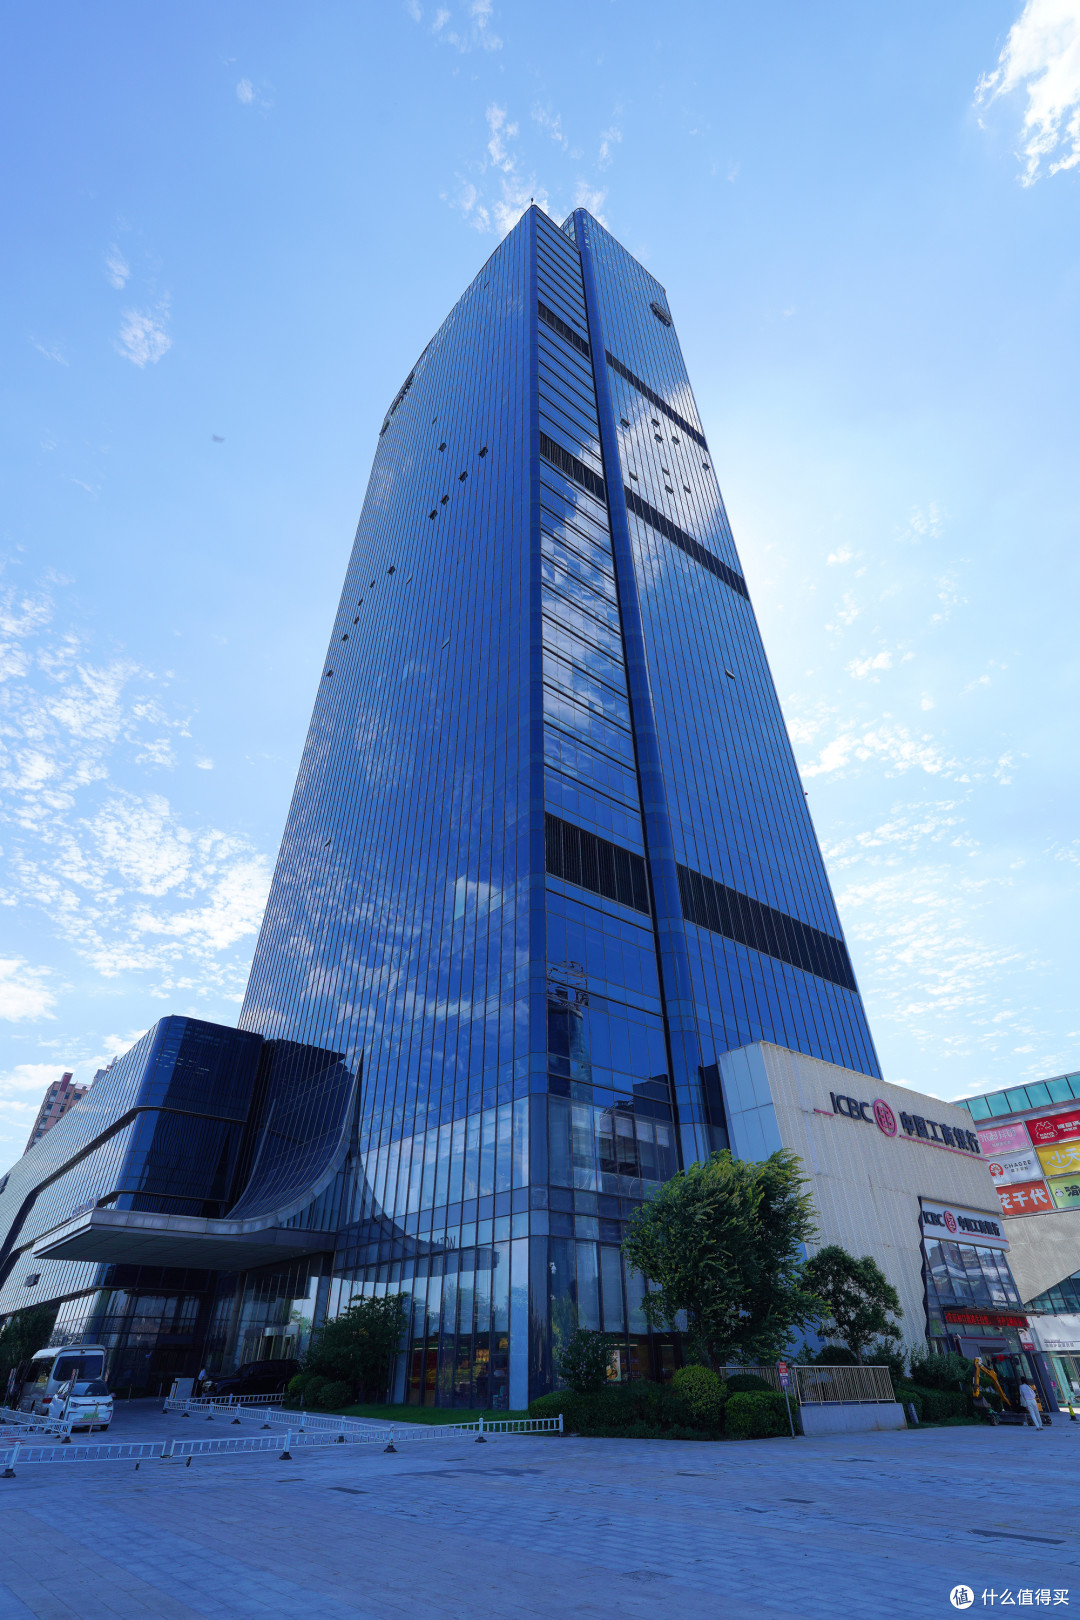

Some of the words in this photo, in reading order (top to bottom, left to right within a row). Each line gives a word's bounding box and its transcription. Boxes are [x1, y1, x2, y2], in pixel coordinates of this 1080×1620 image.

[829, 1091, 874, 1124] ICBC
[898, 1111, 981, 1154] 中国工商银行
[922, 1210, 945, 1227] ICBC
[957, 1215, 1000, 1237] 中国工商银行
